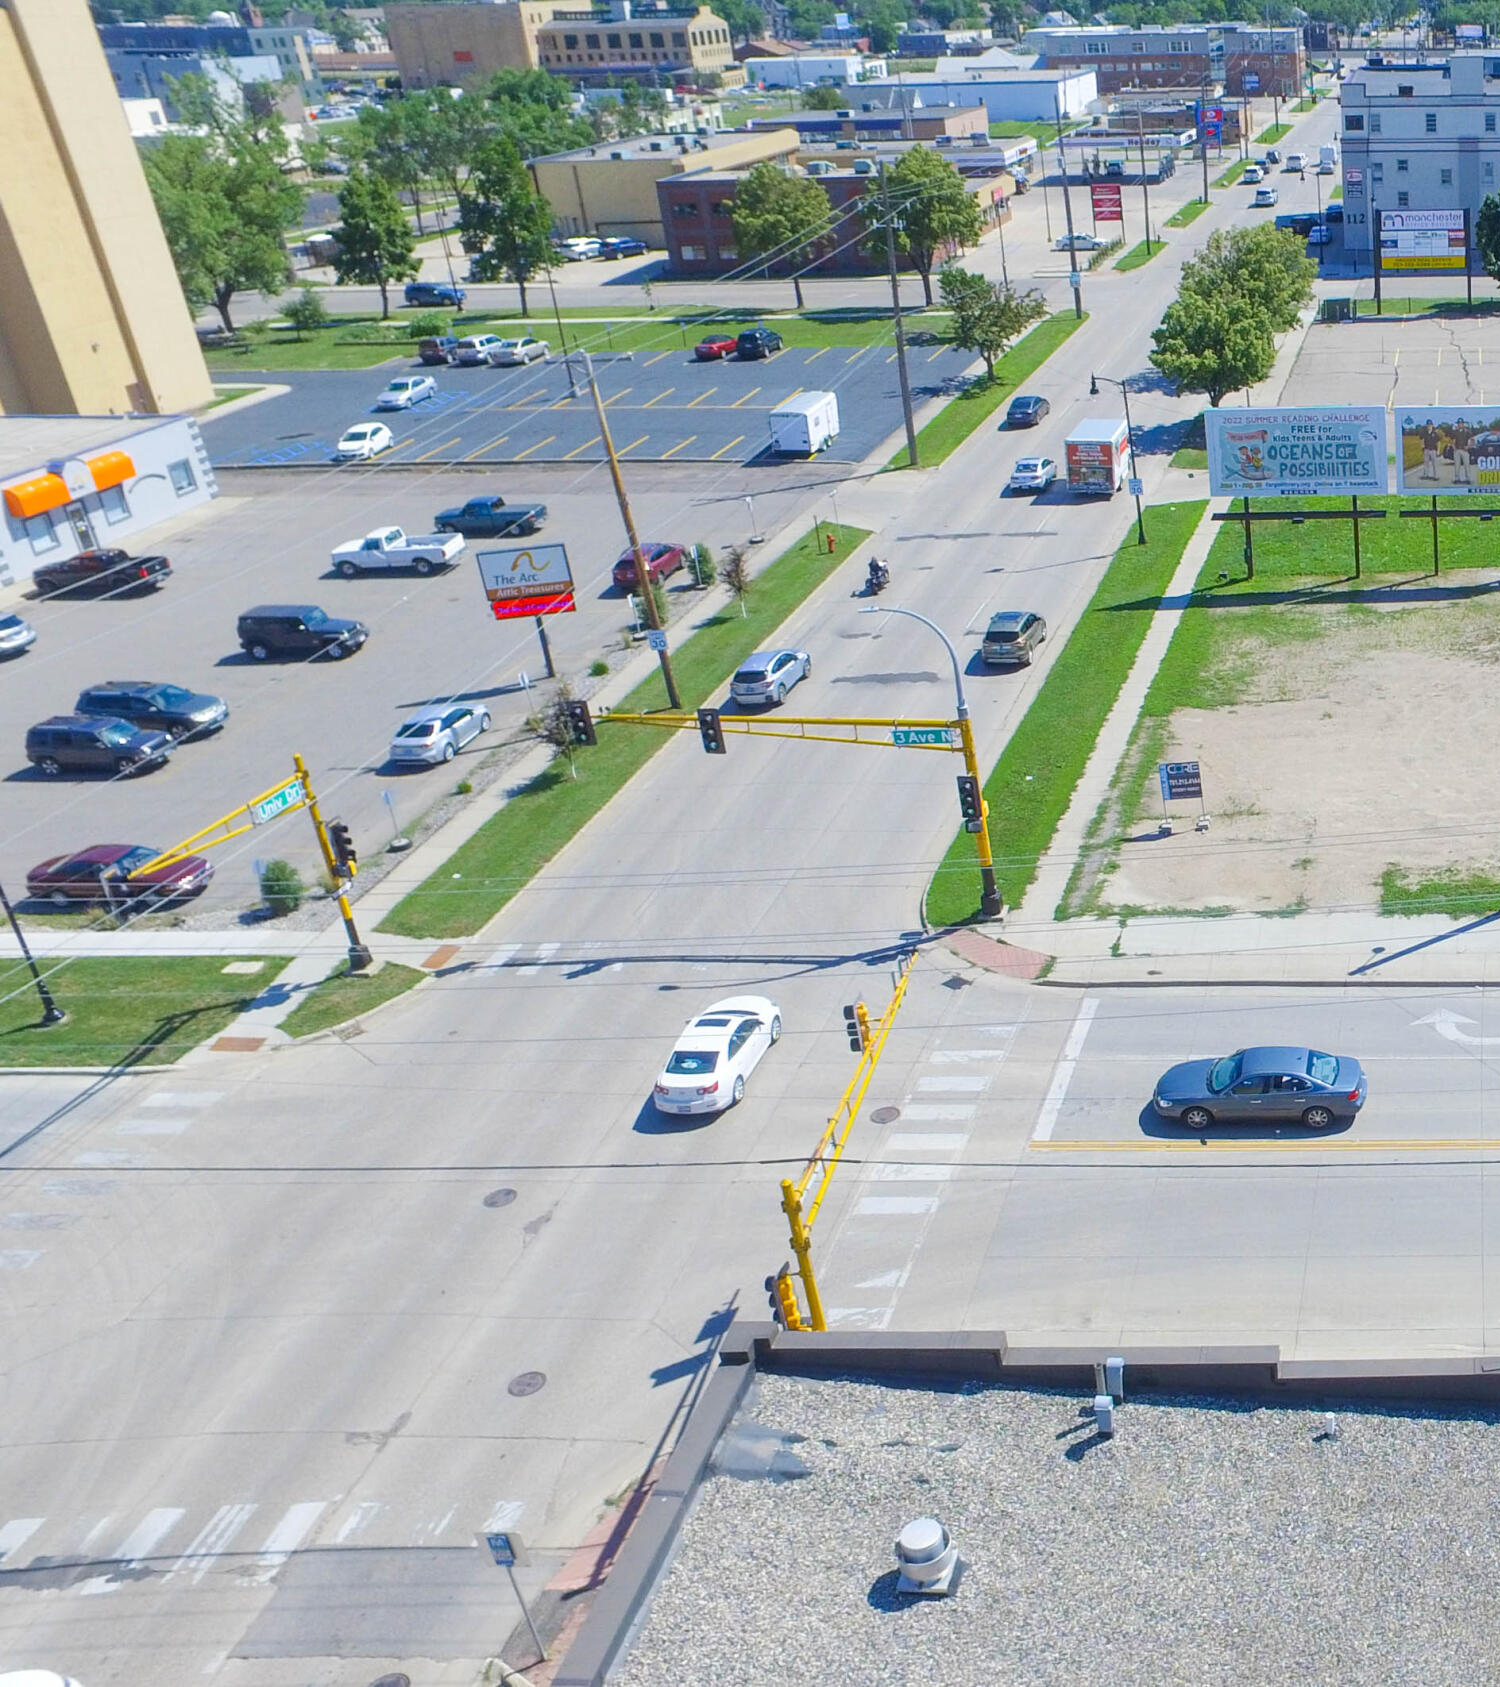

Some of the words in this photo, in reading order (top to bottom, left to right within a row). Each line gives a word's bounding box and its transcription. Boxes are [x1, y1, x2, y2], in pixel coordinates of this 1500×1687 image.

[1127, 138, 1160, 147] Hoday
[1347, 213, 1365, 224] 112
[1405, 213, 1462, 222] manchester
[1222, 416, 1241, 424] 2022
[1245, 416, 1278, 424] SUMMER
[1282, 415, 1319, 423] READING
[1322, 414, 1370, 422] CHALLENGE
[1291, 425, 1315, 434] FREE
[1318, 425, 1333, 433] for
[1267, 443, 1333, 461] OCEANS
[1338, 446, 1354, 458] OF
[1280, 461, 1370, 478] POSSIBILITIES
[494, 575, 516, 586] The
[519, 573, 538, 583] Arc
[496, 588, 518, 599] Attic
[520, 583, 565, 596] Treasures
[651, 640, 666, 648] 30
[896, 732, 905, 743] 3
[909, 732, 935, 743] Ave
[941, 731, 952, 742] N
[1168, 763, 1199, 774] CORE
[259, 797, 283, 818] Univ
[285, 785, 301, 801] Dr
